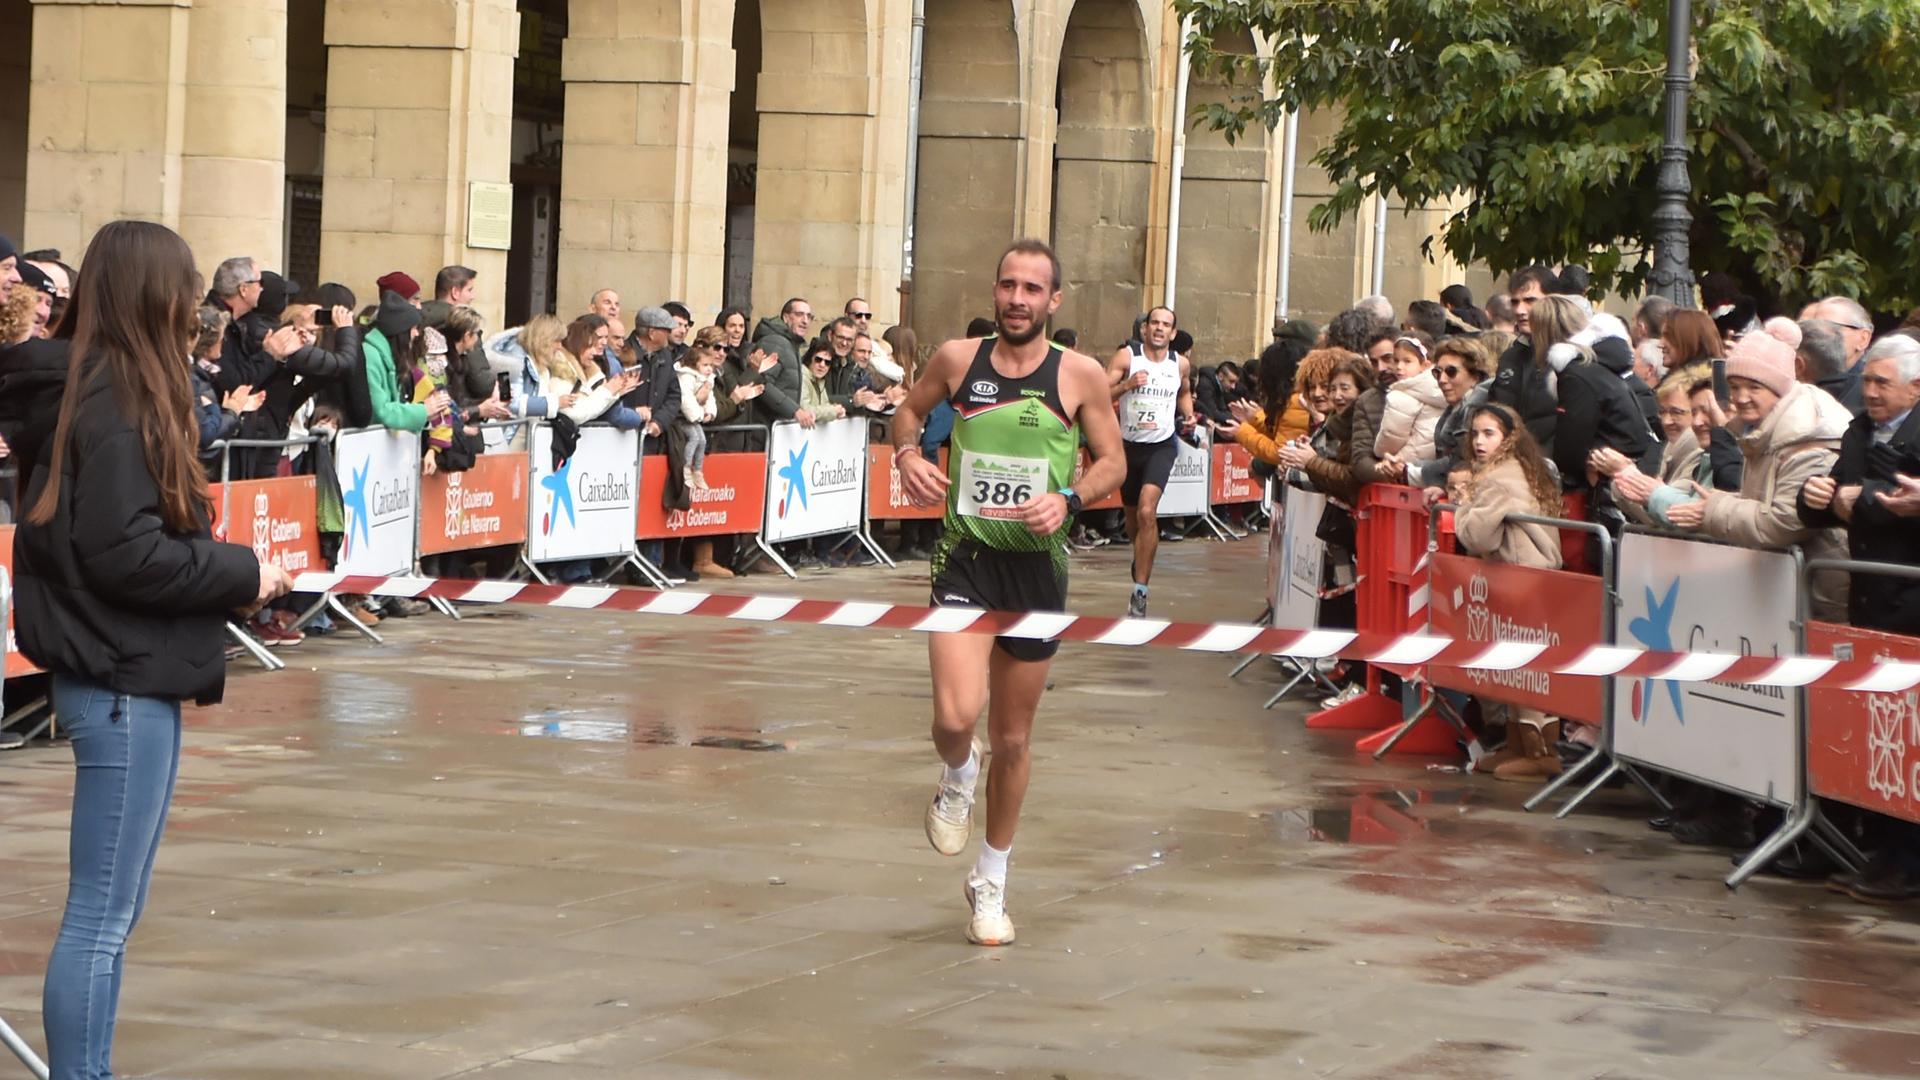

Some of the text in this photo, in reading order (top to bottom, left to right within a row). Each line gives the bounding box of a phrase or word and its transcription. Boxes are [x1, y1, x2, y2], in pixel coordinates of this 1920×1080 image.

[1138, 411, 1156, 422] 75
[811, 458, 857, 488] CaixaBank
[1170, 456, 1204, 477] aixaBank
[372, 476, 410, 516] CaixaBank
[462, 489, 494, 509] Gobierno
[578, 472, 630, 503] CaixaBank
[972, 480, 1032, 506] 386
[471, 514, 500, 534] Navarra
[686, 508, 727, 526] Gobernua
[271, 518, 301, 543] Gobierno
[281, 548, 308, 572] Navarra
